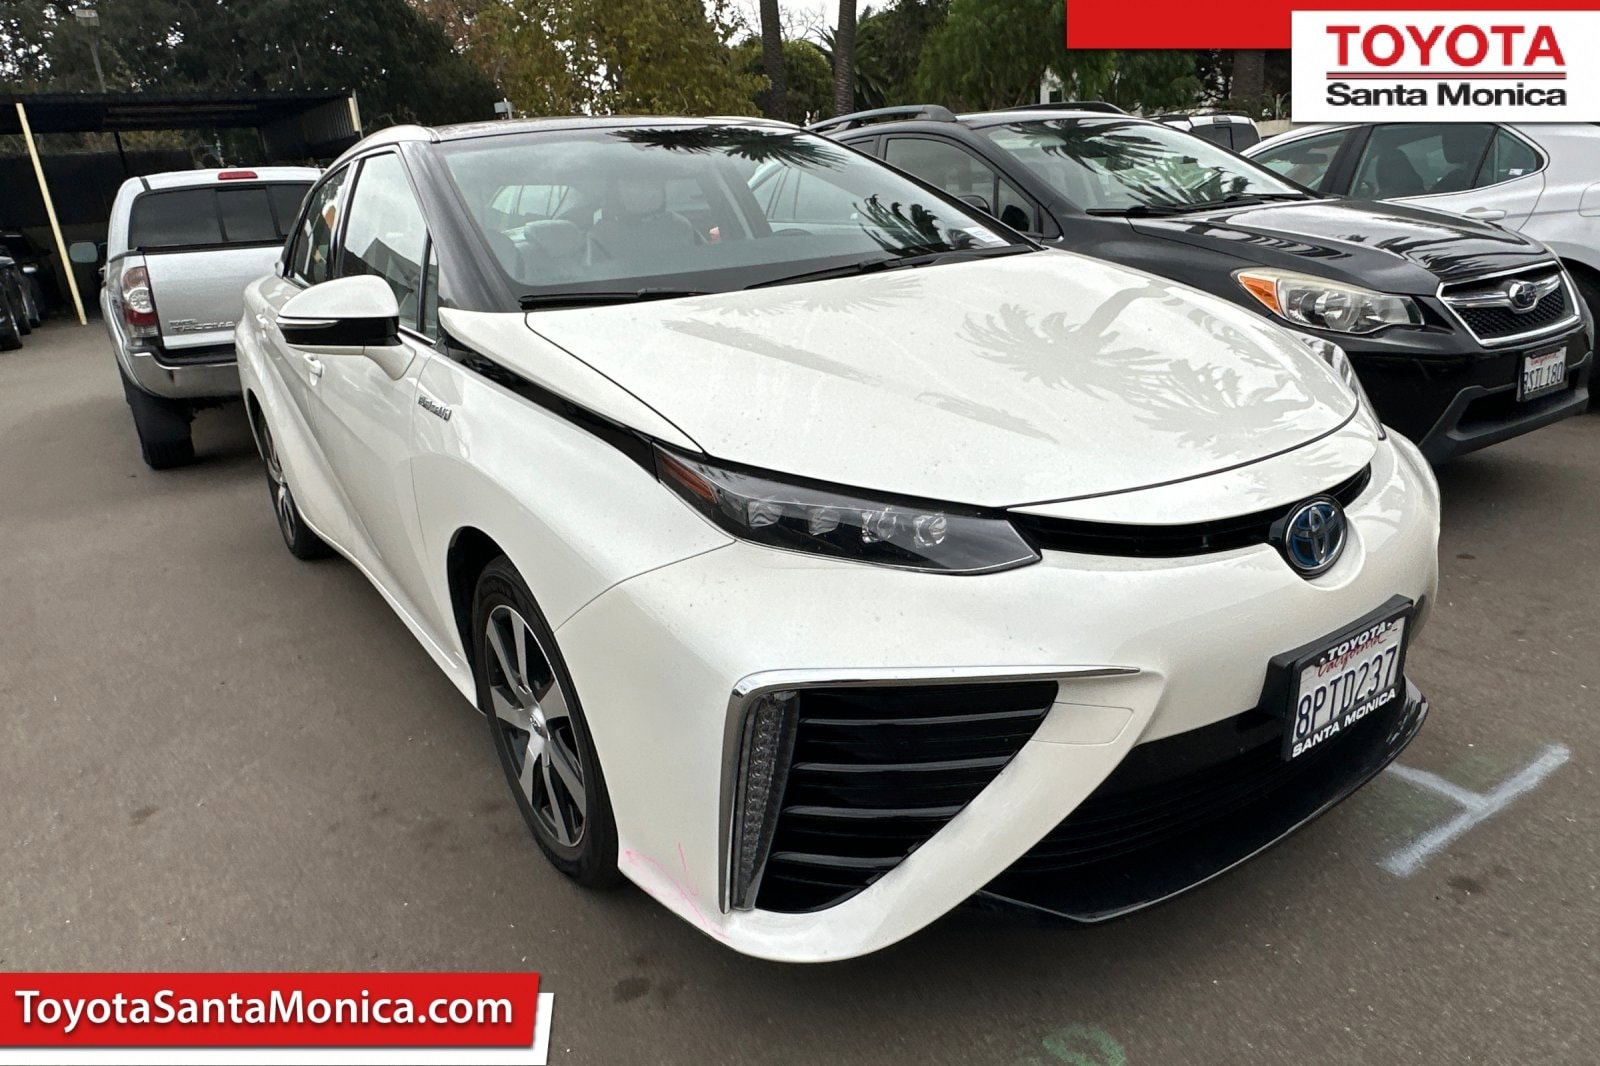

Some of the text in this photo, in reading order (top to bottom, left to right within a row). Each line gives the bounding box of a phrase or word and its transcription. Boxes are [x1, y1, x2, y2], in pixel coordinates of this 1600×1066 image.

[1327, 621, 1385, 660] TOYOTA
[1292, 688, 1396, 758] SANTA MONICA
[1296, 644, 1398, 739] 8PTD237
